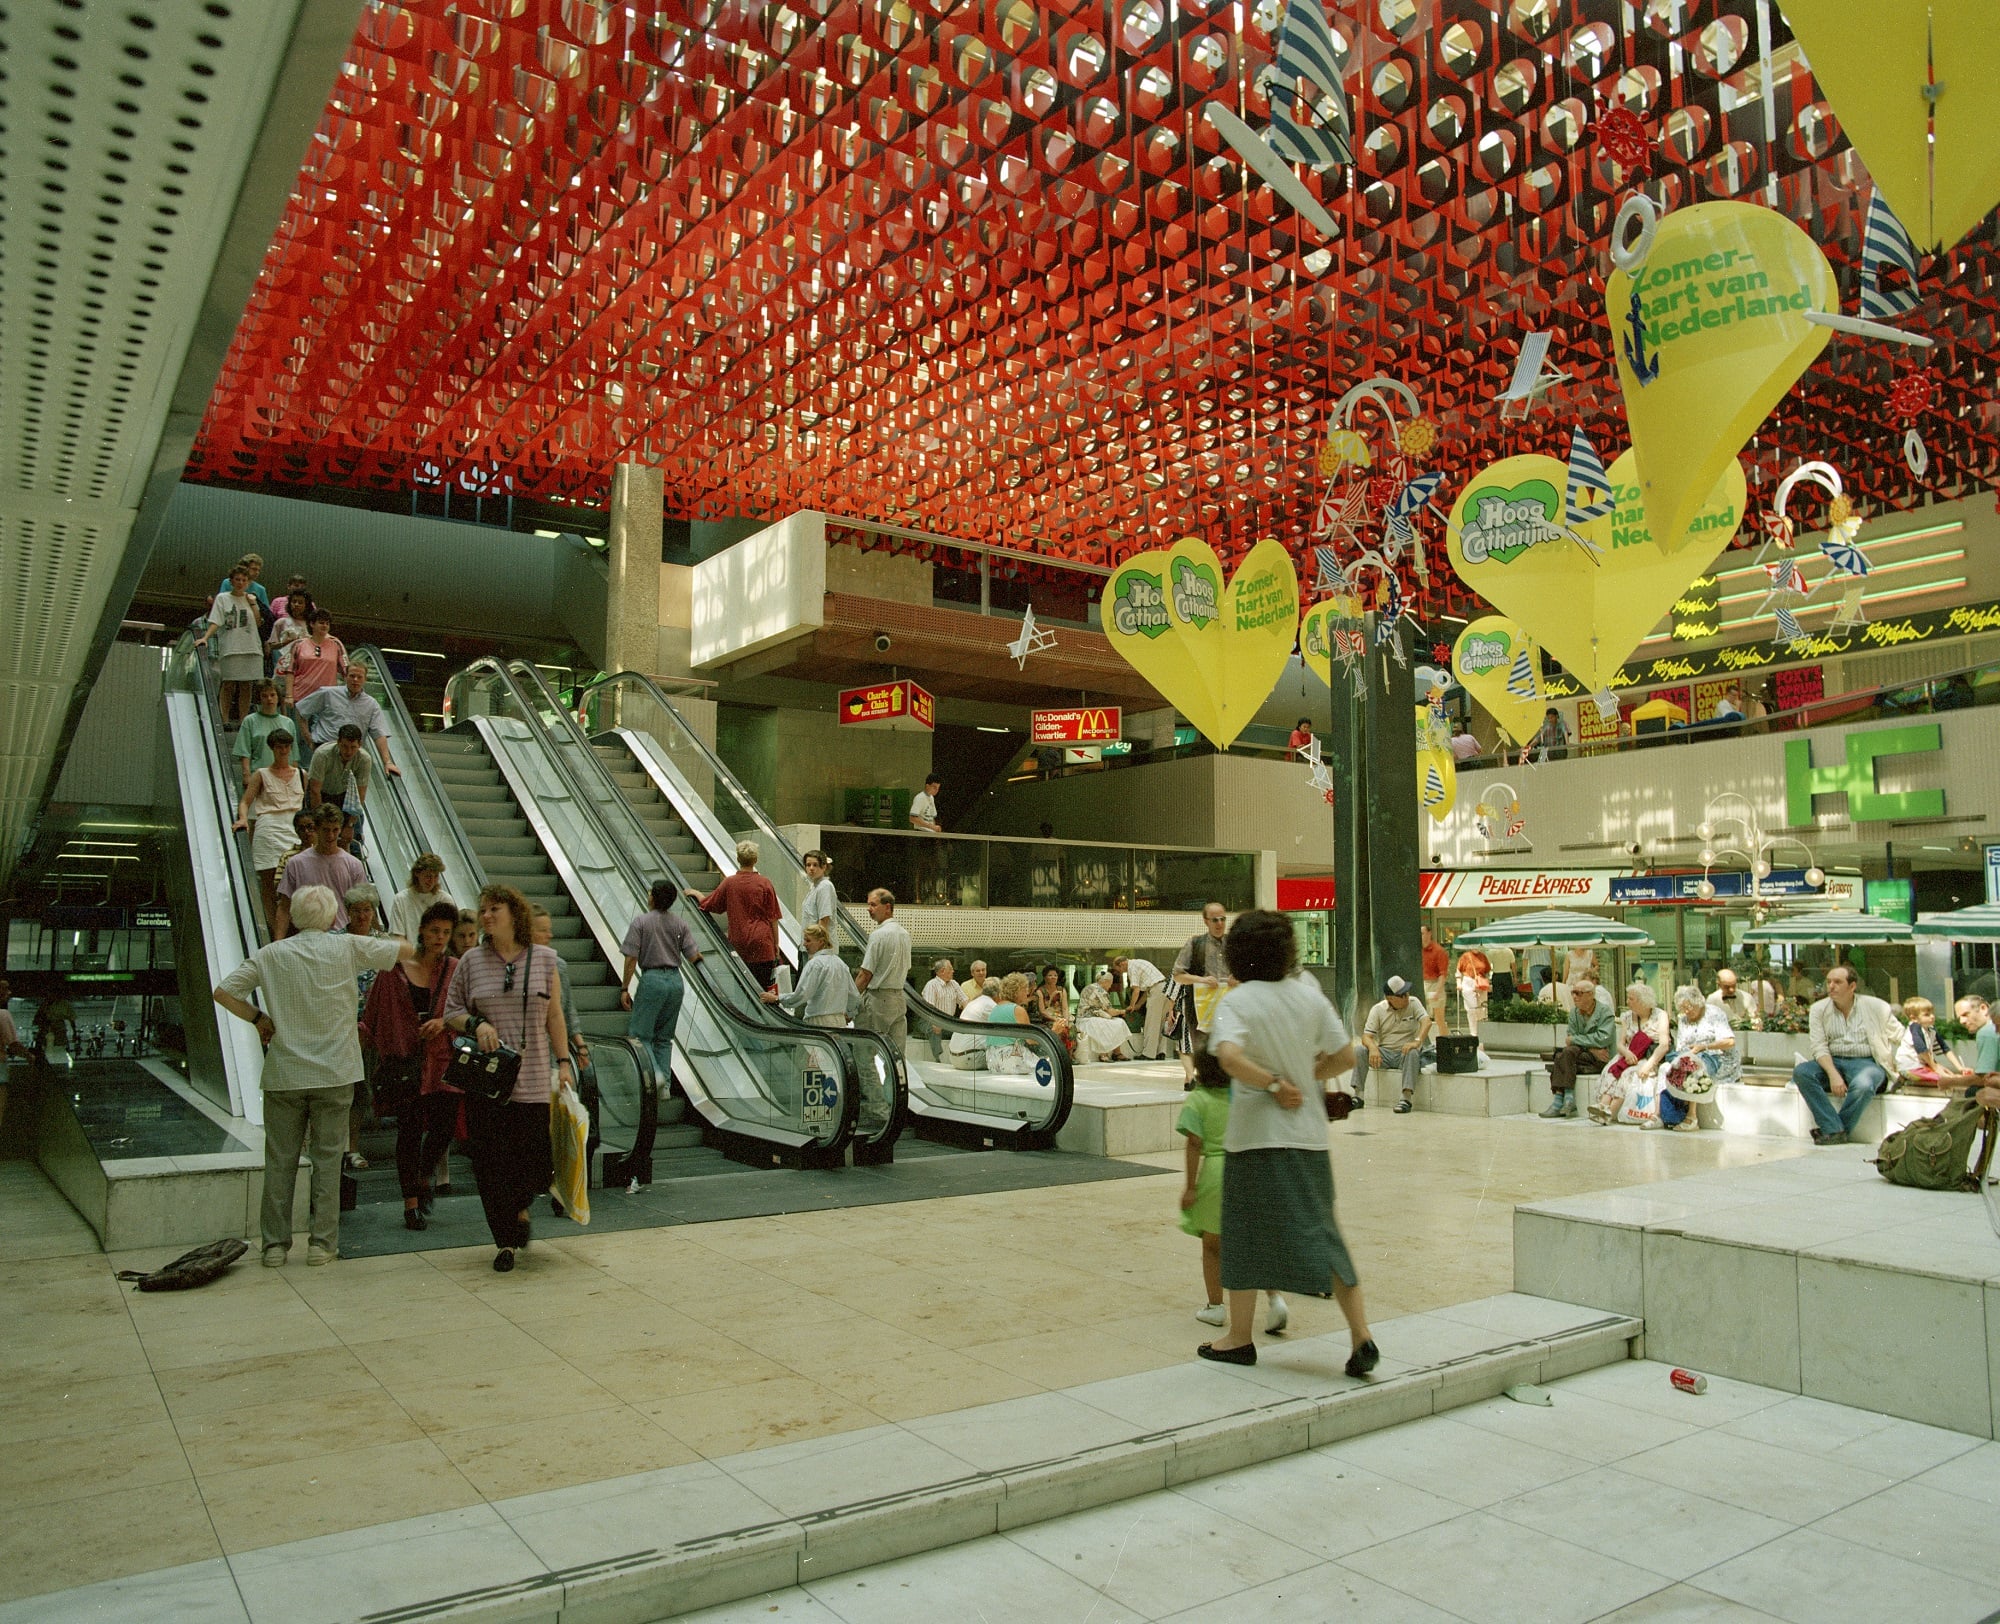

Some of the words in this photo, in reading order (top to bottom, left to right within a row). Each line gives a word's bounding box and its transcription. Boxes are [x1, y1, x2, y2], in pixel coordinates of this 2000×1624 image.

[1628, 249, 1754, 294] Zomer-
[1706, 271, 1768, 299] van
[1642, 285, 1811, 351] Nederland
[1479, 498, 1545, 530] Hoog
[1182, 569, 1215, 605] Hoog
[1235, 572, 1278, 597] Zomer-
[1235, 596, 1264, 614] hart
[1266, 588, 1283, 602] van
[1236, 598, 1295, 631] Nederland
[1469, 638, 1504, 656] Hoog
[867, 689, 889, 700] Charlie
[1035, 723, 1063, 731] Gilden-
[1035, 731, 1068, 740] kwartier
[1479, 875, 1532, 895] PEARLE
[1532, 874, 1593, 895] EXPRESS
[1625, 888, 1656, 897] Vredenburg
[1305, 898, 1335, 907] OPTI
[136, 918, 171, 927] Clarenburg
[803, 1071, 824, 1089] LE
